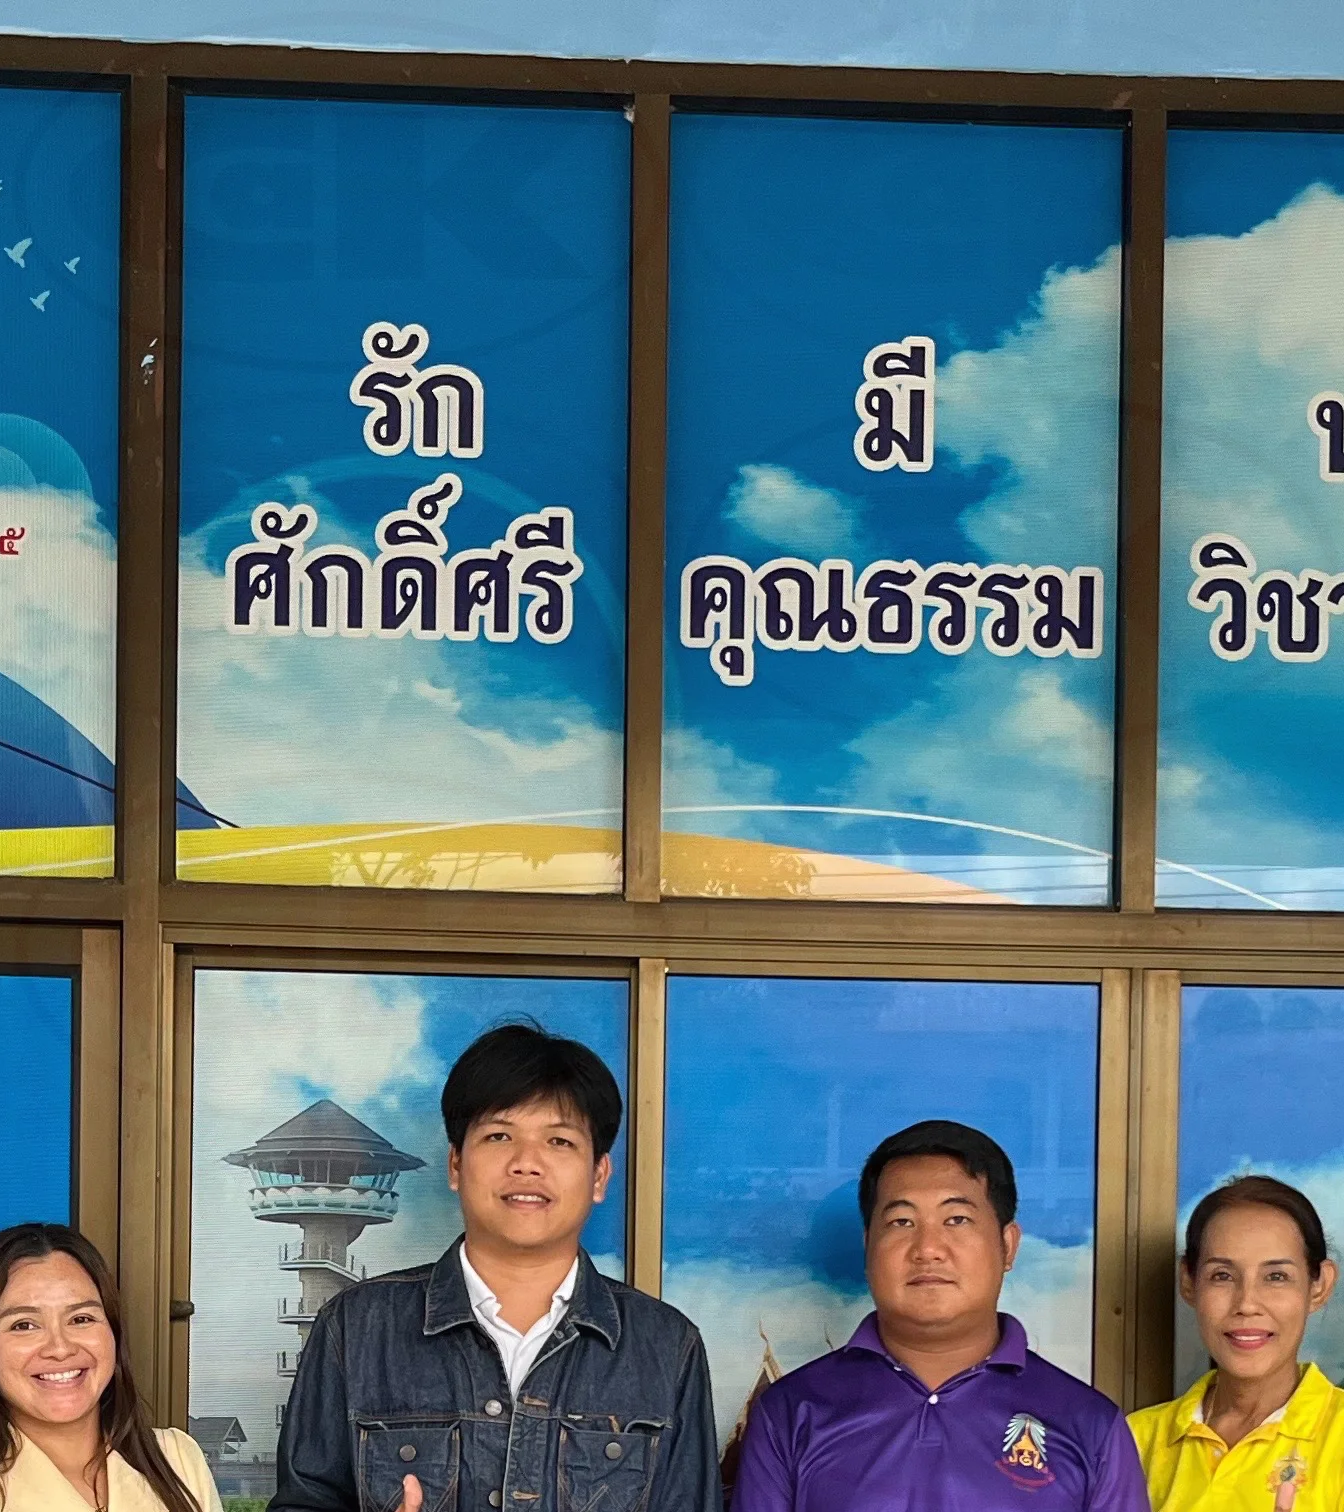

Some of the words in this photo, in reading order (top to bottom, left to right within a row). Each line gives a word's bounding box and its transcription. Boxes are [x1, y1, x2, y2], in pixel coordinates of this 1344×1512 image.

[359, 331, 475, 451] รัก
[861, 346, 927, 464] มี
[233, 480, 576, 636] ศักดิ์ศรี
[688, 561, 1097, 678] คุณธรรม
